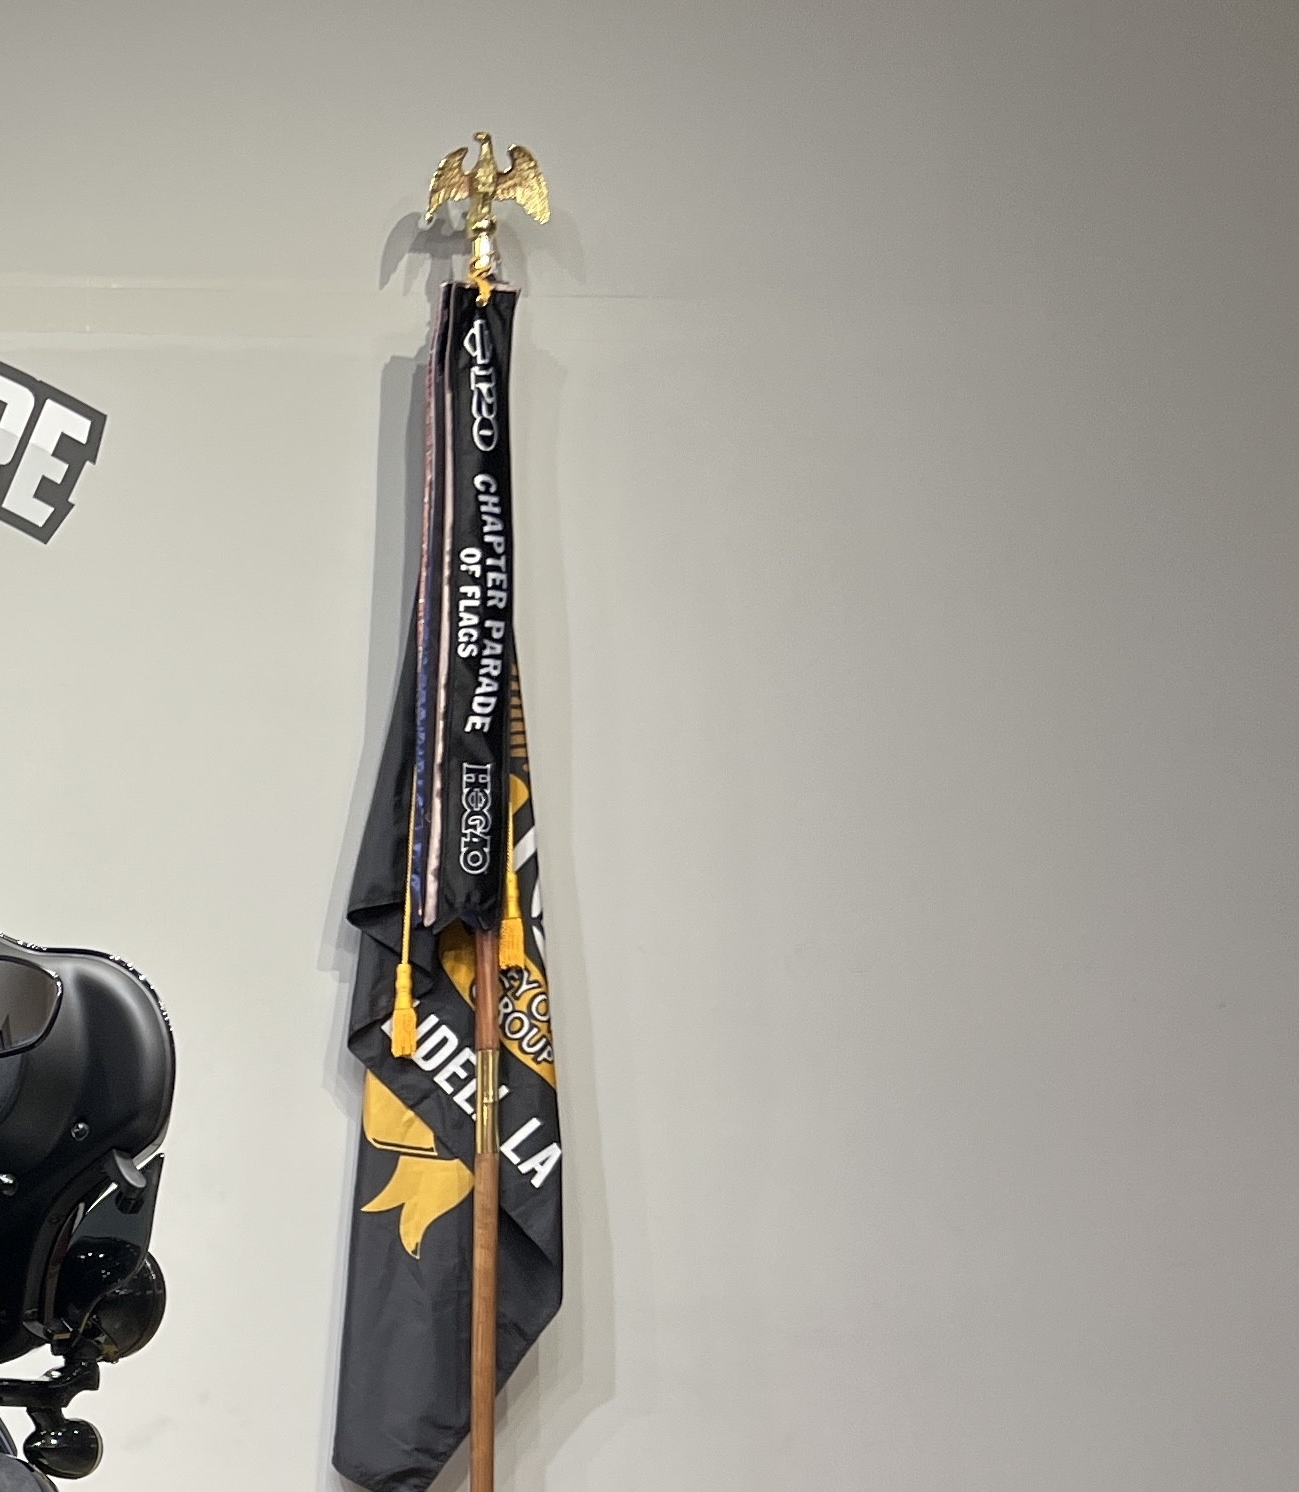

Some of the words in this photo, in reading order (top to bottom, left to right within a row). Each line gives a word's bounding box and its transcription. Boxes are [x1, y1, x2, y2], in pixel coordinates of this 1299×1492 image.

[458, 546, 483, 579] OF
[473, 472, 509, 611] CHAPTER
[456, 584, 482, 659] FLAGS
[464, 618, 506, 734] PARADE
[499, 1117, 562, 1190] LA
